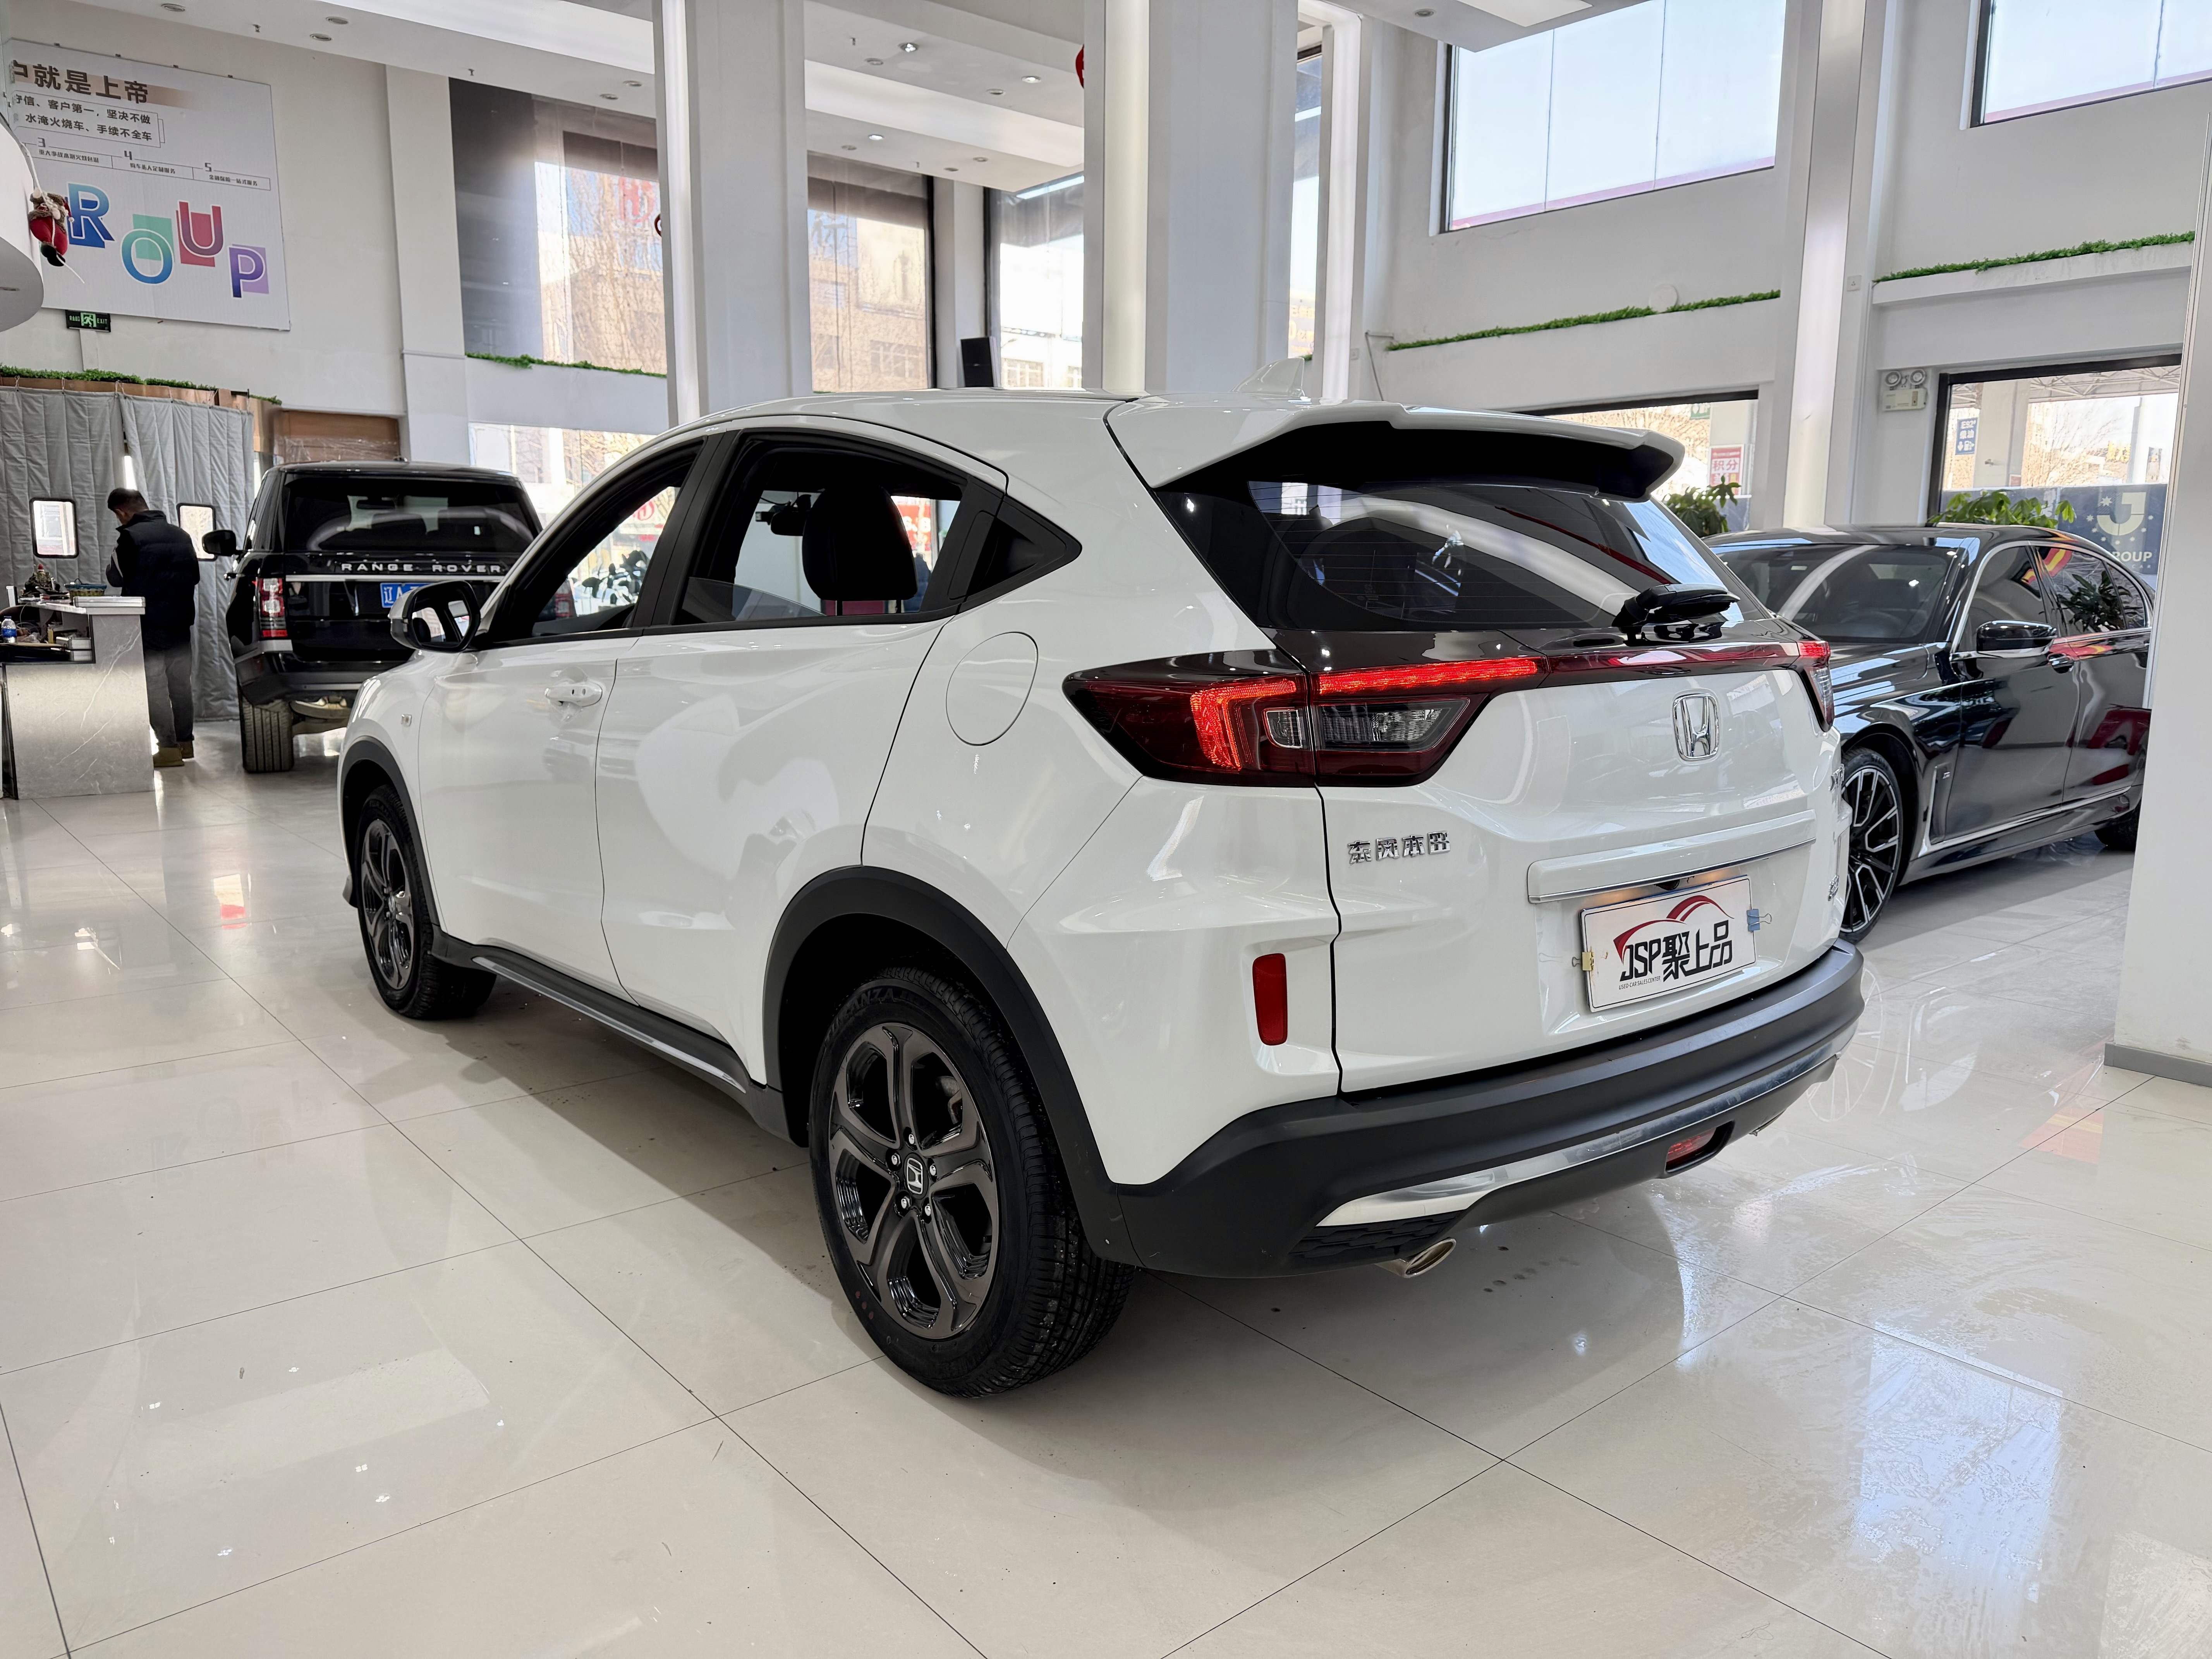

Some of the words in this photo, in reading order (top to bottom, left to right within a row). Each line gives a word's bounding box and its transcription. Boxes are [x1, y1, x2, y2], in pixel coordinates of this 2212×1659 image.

[38, 137, 46, 148] 3
[124, 150, 132, 160] 4
[204, 162, 212, 172] 5
[2112, 551, 2153, 562] ROUP
[341, 563, 414, 572] RANGE
[432, 564, 501, 573] ROVER
[1348, 831, 1451, 865] 东风本田
